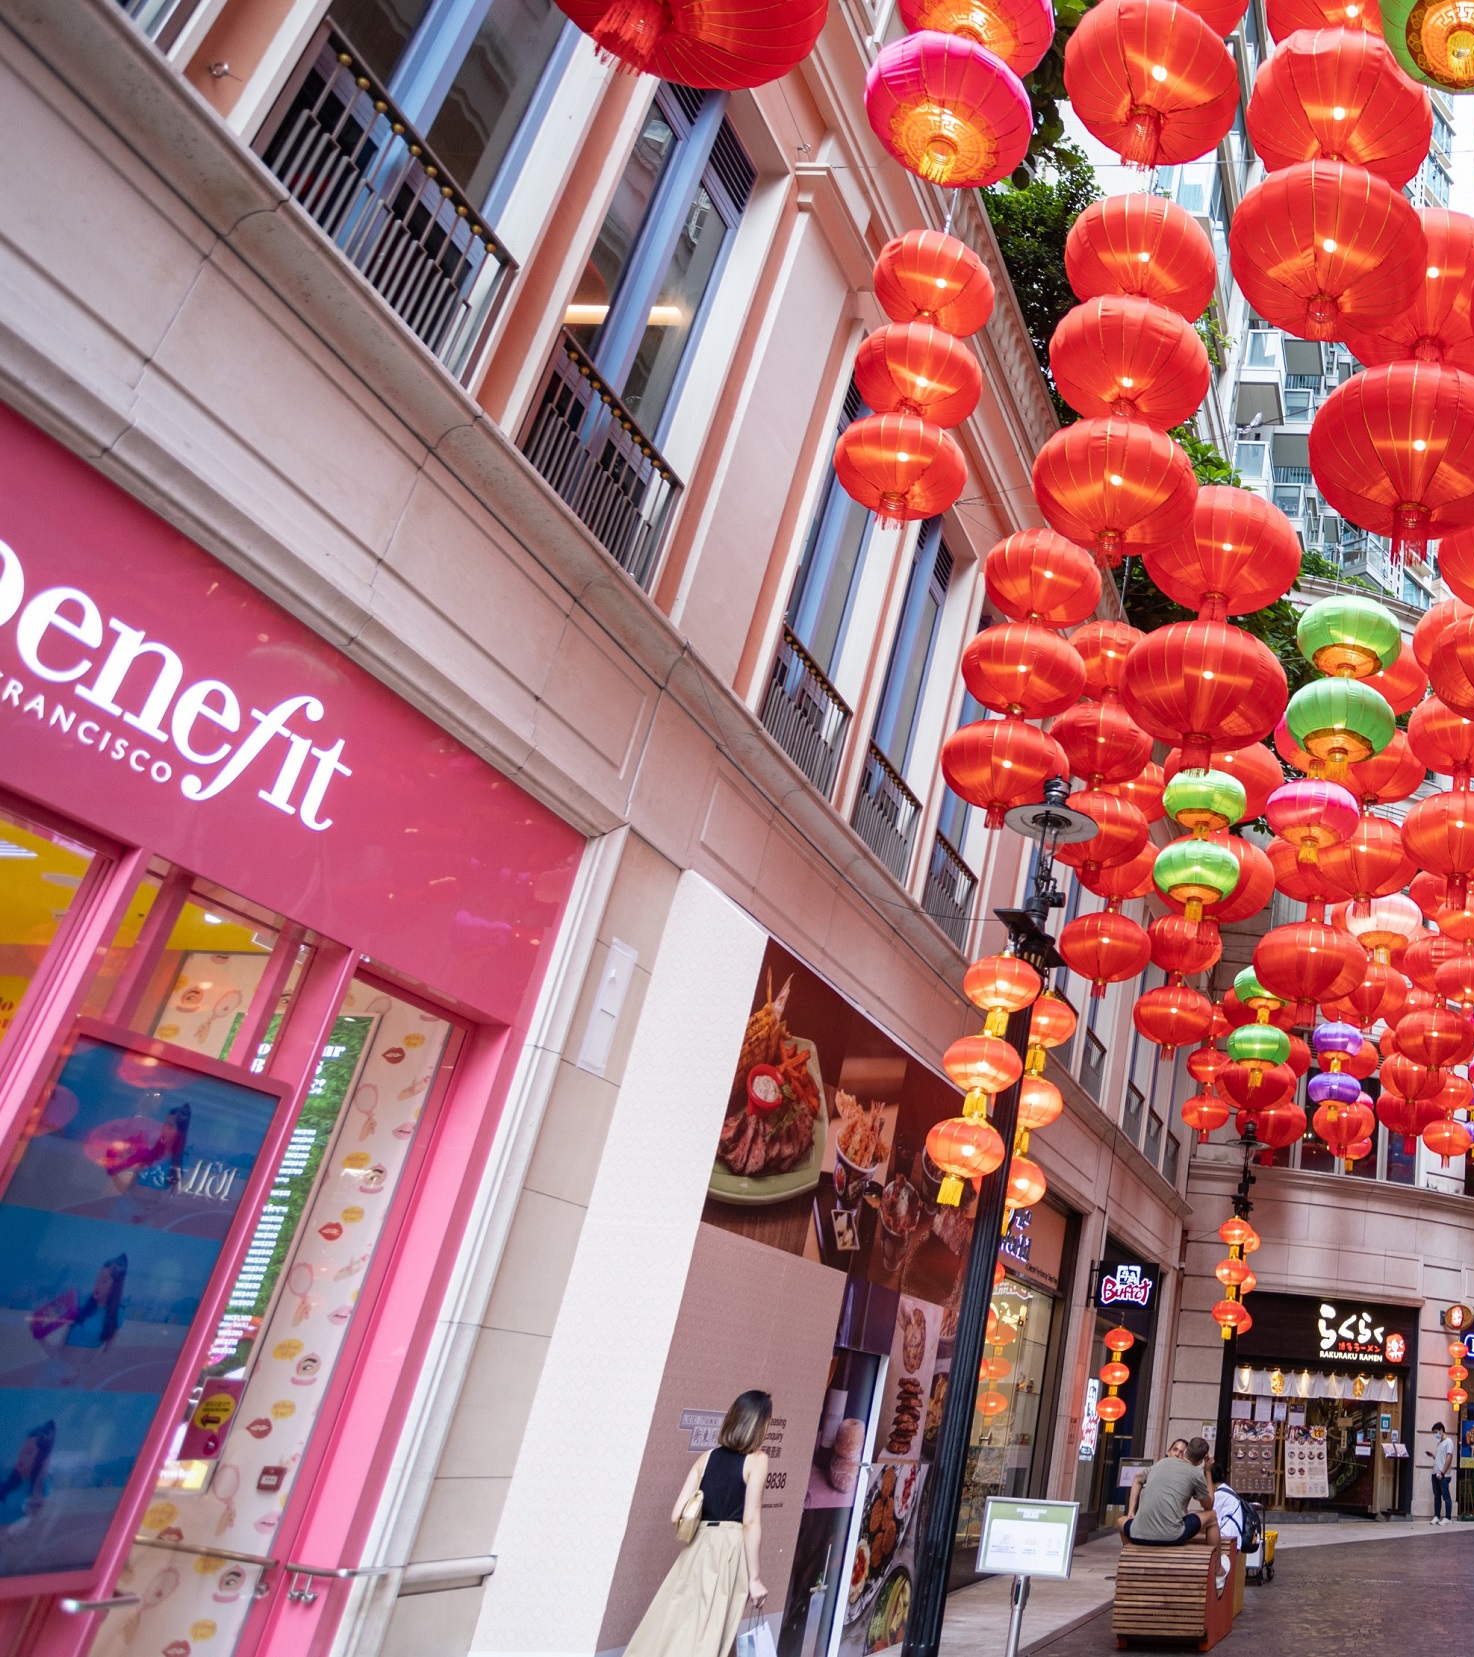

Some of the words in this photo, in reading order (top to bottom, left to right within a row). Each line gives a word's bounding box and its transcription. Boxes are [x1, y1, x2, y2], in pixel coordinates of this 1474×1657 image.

[0, 538, 352, 831] enefit
[0, 670, 172, 783] RANCISCO
[1102, 1277, 1152, 1305] Buffet
[1318, 1303, 1385, 1350] らくらく
[1319, 1350, 1358, 1361] RAKURAKU
[1358, 1353, 1383, 1363] RAMEN
[770, 1417, 787, 1429] easing
[765, 1472, 788, 1490] 9838
